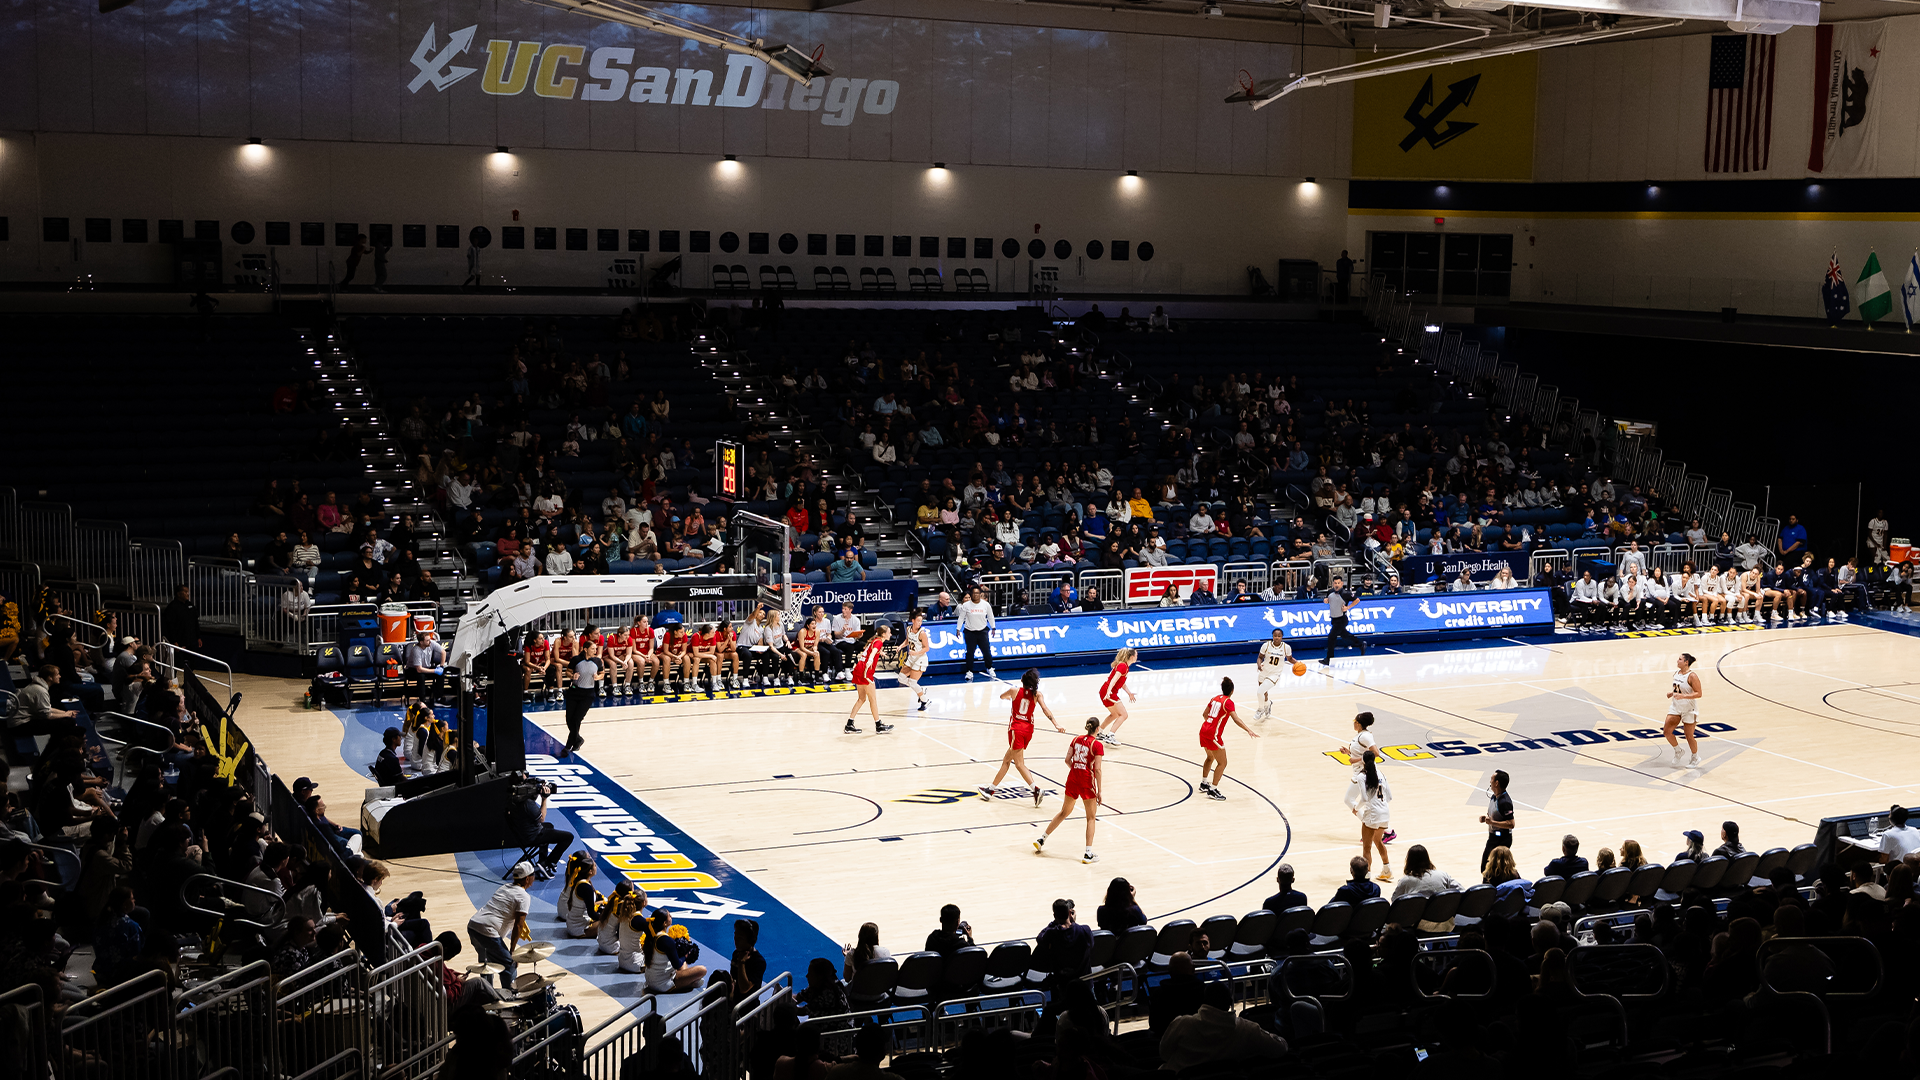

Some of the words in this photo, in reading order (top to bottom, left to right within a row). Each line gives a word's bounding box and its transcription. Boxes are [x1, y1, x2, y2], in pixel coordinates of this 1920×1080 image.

[1830, 49, 1841, 98] CALIFORNIA
[1827, 101, 1838, 140] REPUBLIC
[723, 464, 735, 493] 28
[1458, 560, 1481, 574] Diego
[1482, 559, 1509, 572] Health
[689, 586, 724, 597] SPALDING
[1129, 569, 1215, 598] ESPN
[803, 594, 823, 605] San
[824, 590, 856, 604] Diego
[857, 588, 892, 602] Health
[1263, 606, 1395, 628] UNIVESITY
[1418, 598, 1542, 619] UNIVERSITY
[1097, 615, 1238, 638] UNIVERSITY
[1345, 621, 1375, 633] nion
[1444, 614, 1485, 627] credit
[1487, 612, 1524, 625] union
[1126, 633, 1171, 647] credit
[1174, 631, 1216, 645] union
[1615, 623, 1766, 639] TRITONS
[1001, 641, 1047, 655] union
[1269, 655, 1280, 666] 10
[642, 683, 857, 704] TRITONS
[1672, 682, 1682, 694] 21
[1019, 697, 1030, 715] 0
[1208, 700, 1222, 718] 10
